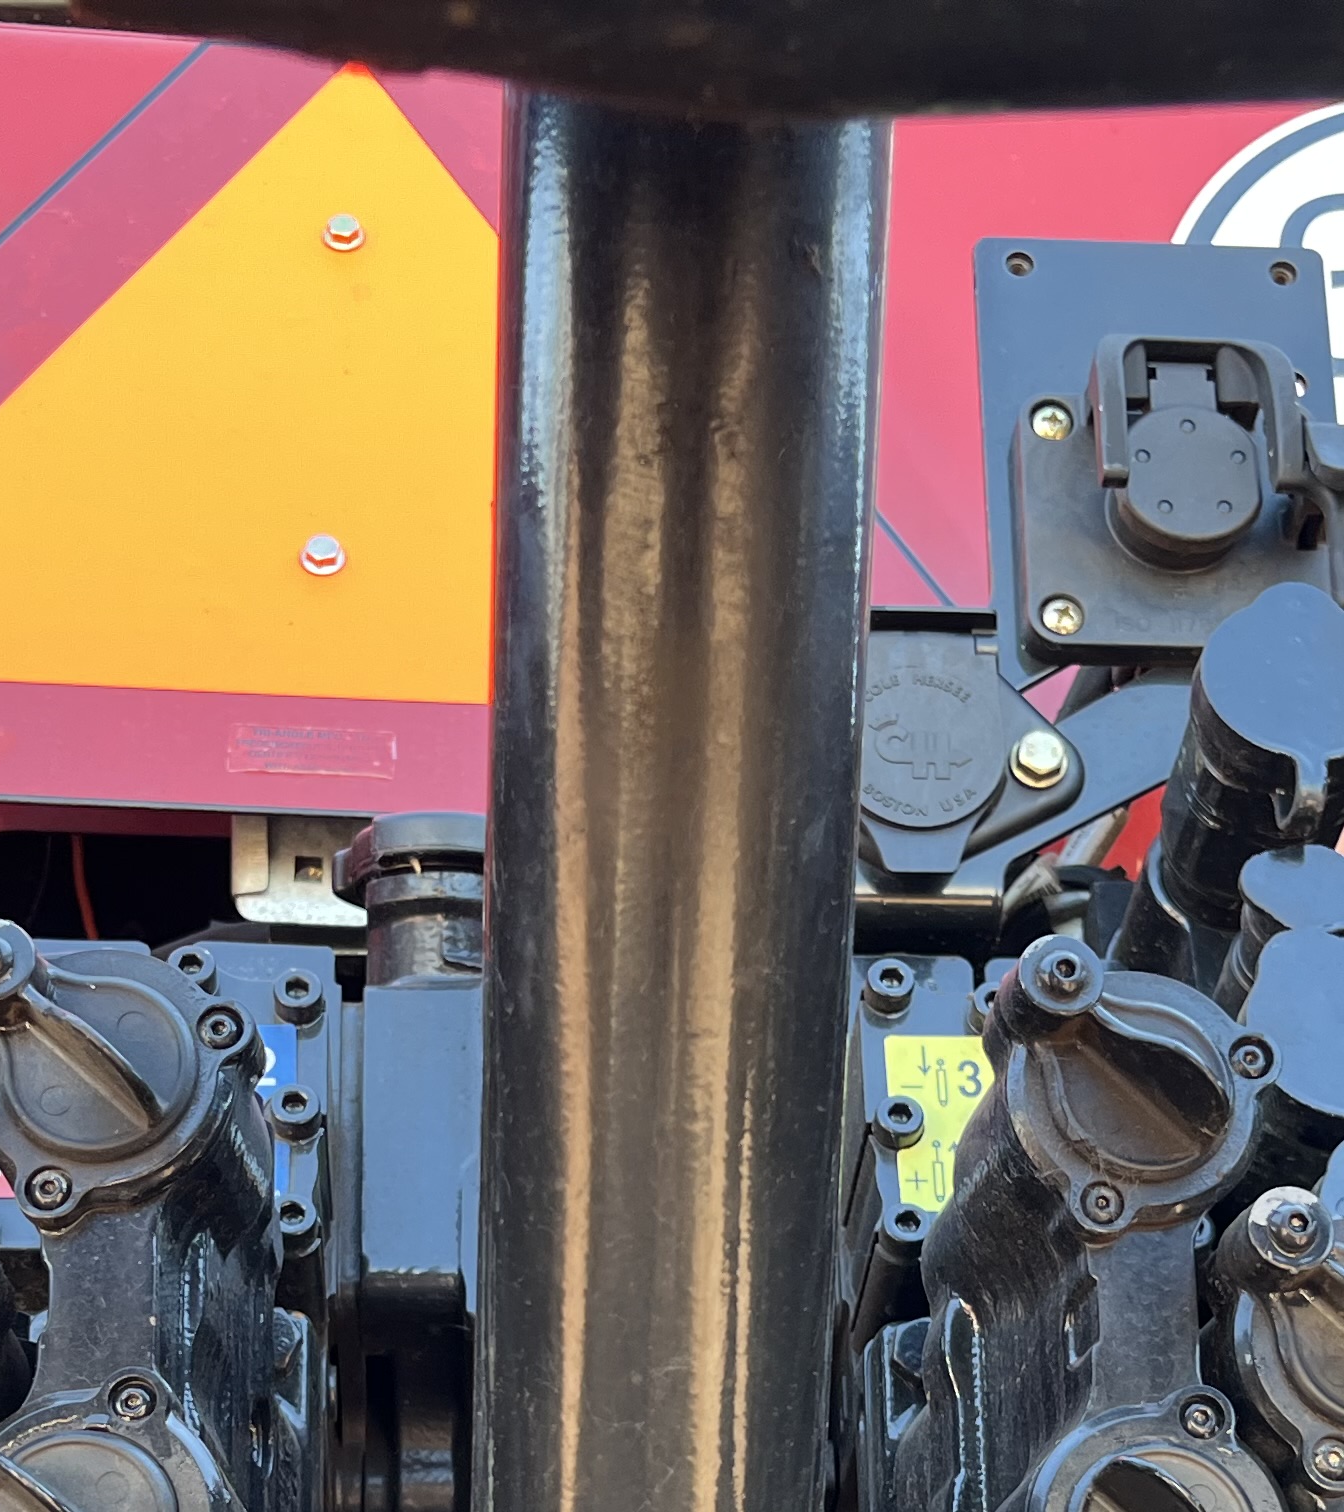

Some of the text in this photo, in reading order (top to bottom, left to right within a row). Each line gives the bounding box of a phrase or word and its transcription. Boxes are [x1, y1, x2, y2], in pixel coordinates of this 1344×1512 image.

[862, 783, 977, 816] BOSTON USA
[957, 1060, 982, 1097] 3
